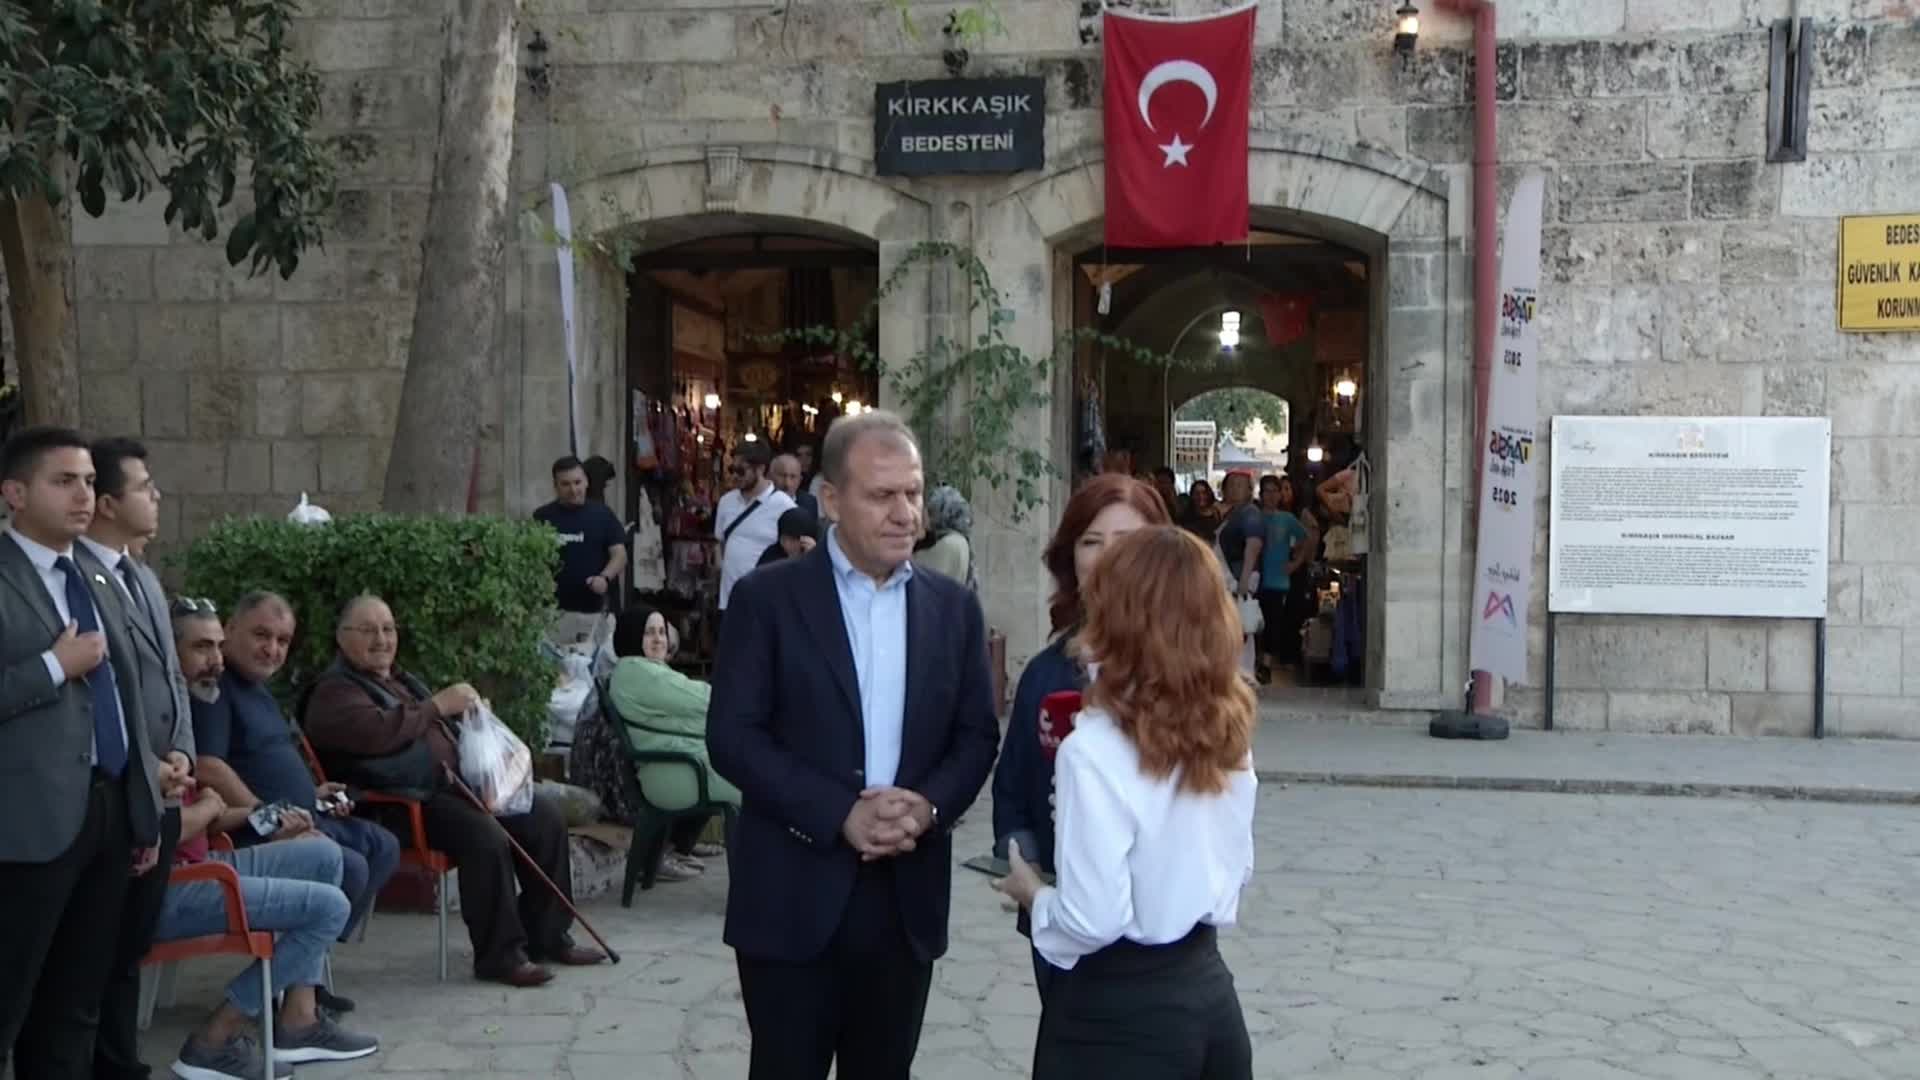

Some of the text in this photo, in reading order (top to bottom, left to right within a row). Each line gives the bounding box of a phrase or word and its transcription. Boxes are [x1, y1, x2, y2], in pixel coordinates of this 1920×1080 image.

[887, 94, 1032, 119] KIRKKAŞIK
[901, 129, 1014, 153] BEDESTENİ
[1848, 260, 1901, 284] GÜVENLİK
